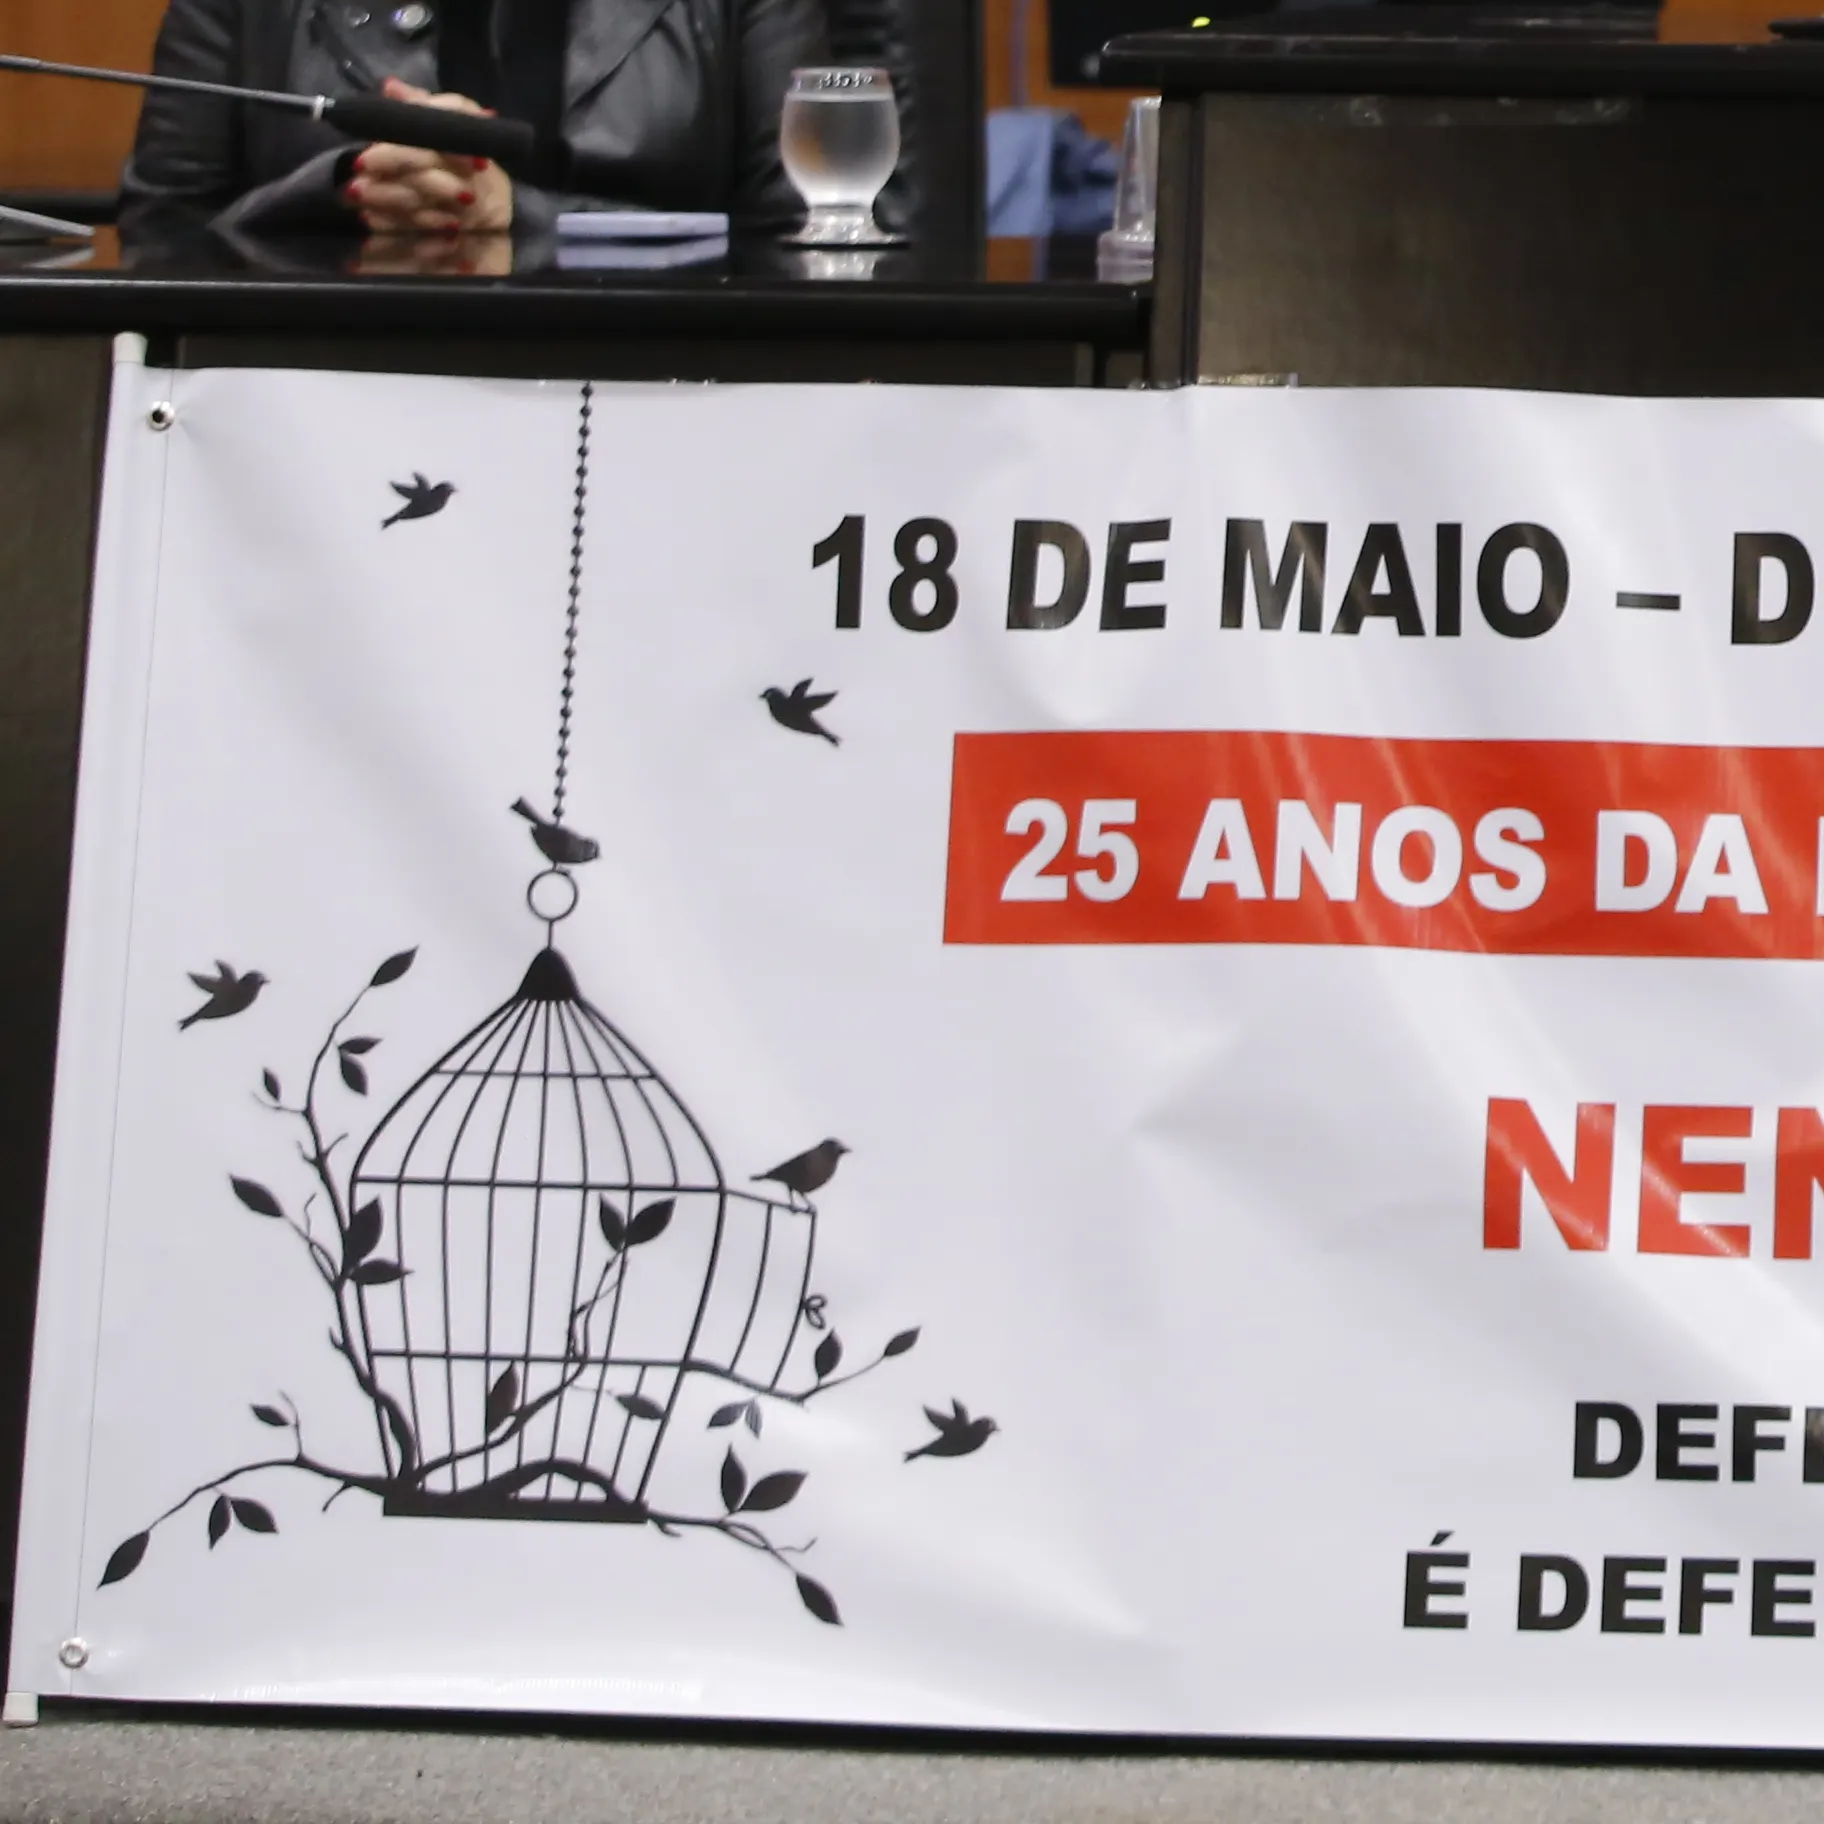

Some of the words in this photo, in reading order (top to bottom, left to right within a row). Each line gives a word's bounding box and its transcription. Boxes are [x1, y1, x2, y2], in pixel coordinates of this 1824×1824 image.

[812, 514, 959, 633] 18
[1005, 518, 1171, 632] DE
[1220, 518, 1570, 640] MAIO
[1000, 798, 1140, 902] 25
[1178, 798, 1548, 912] ANOS
[1595, 810, 1769, 915] DA
[1403, 1531, 1470, 1630] É
